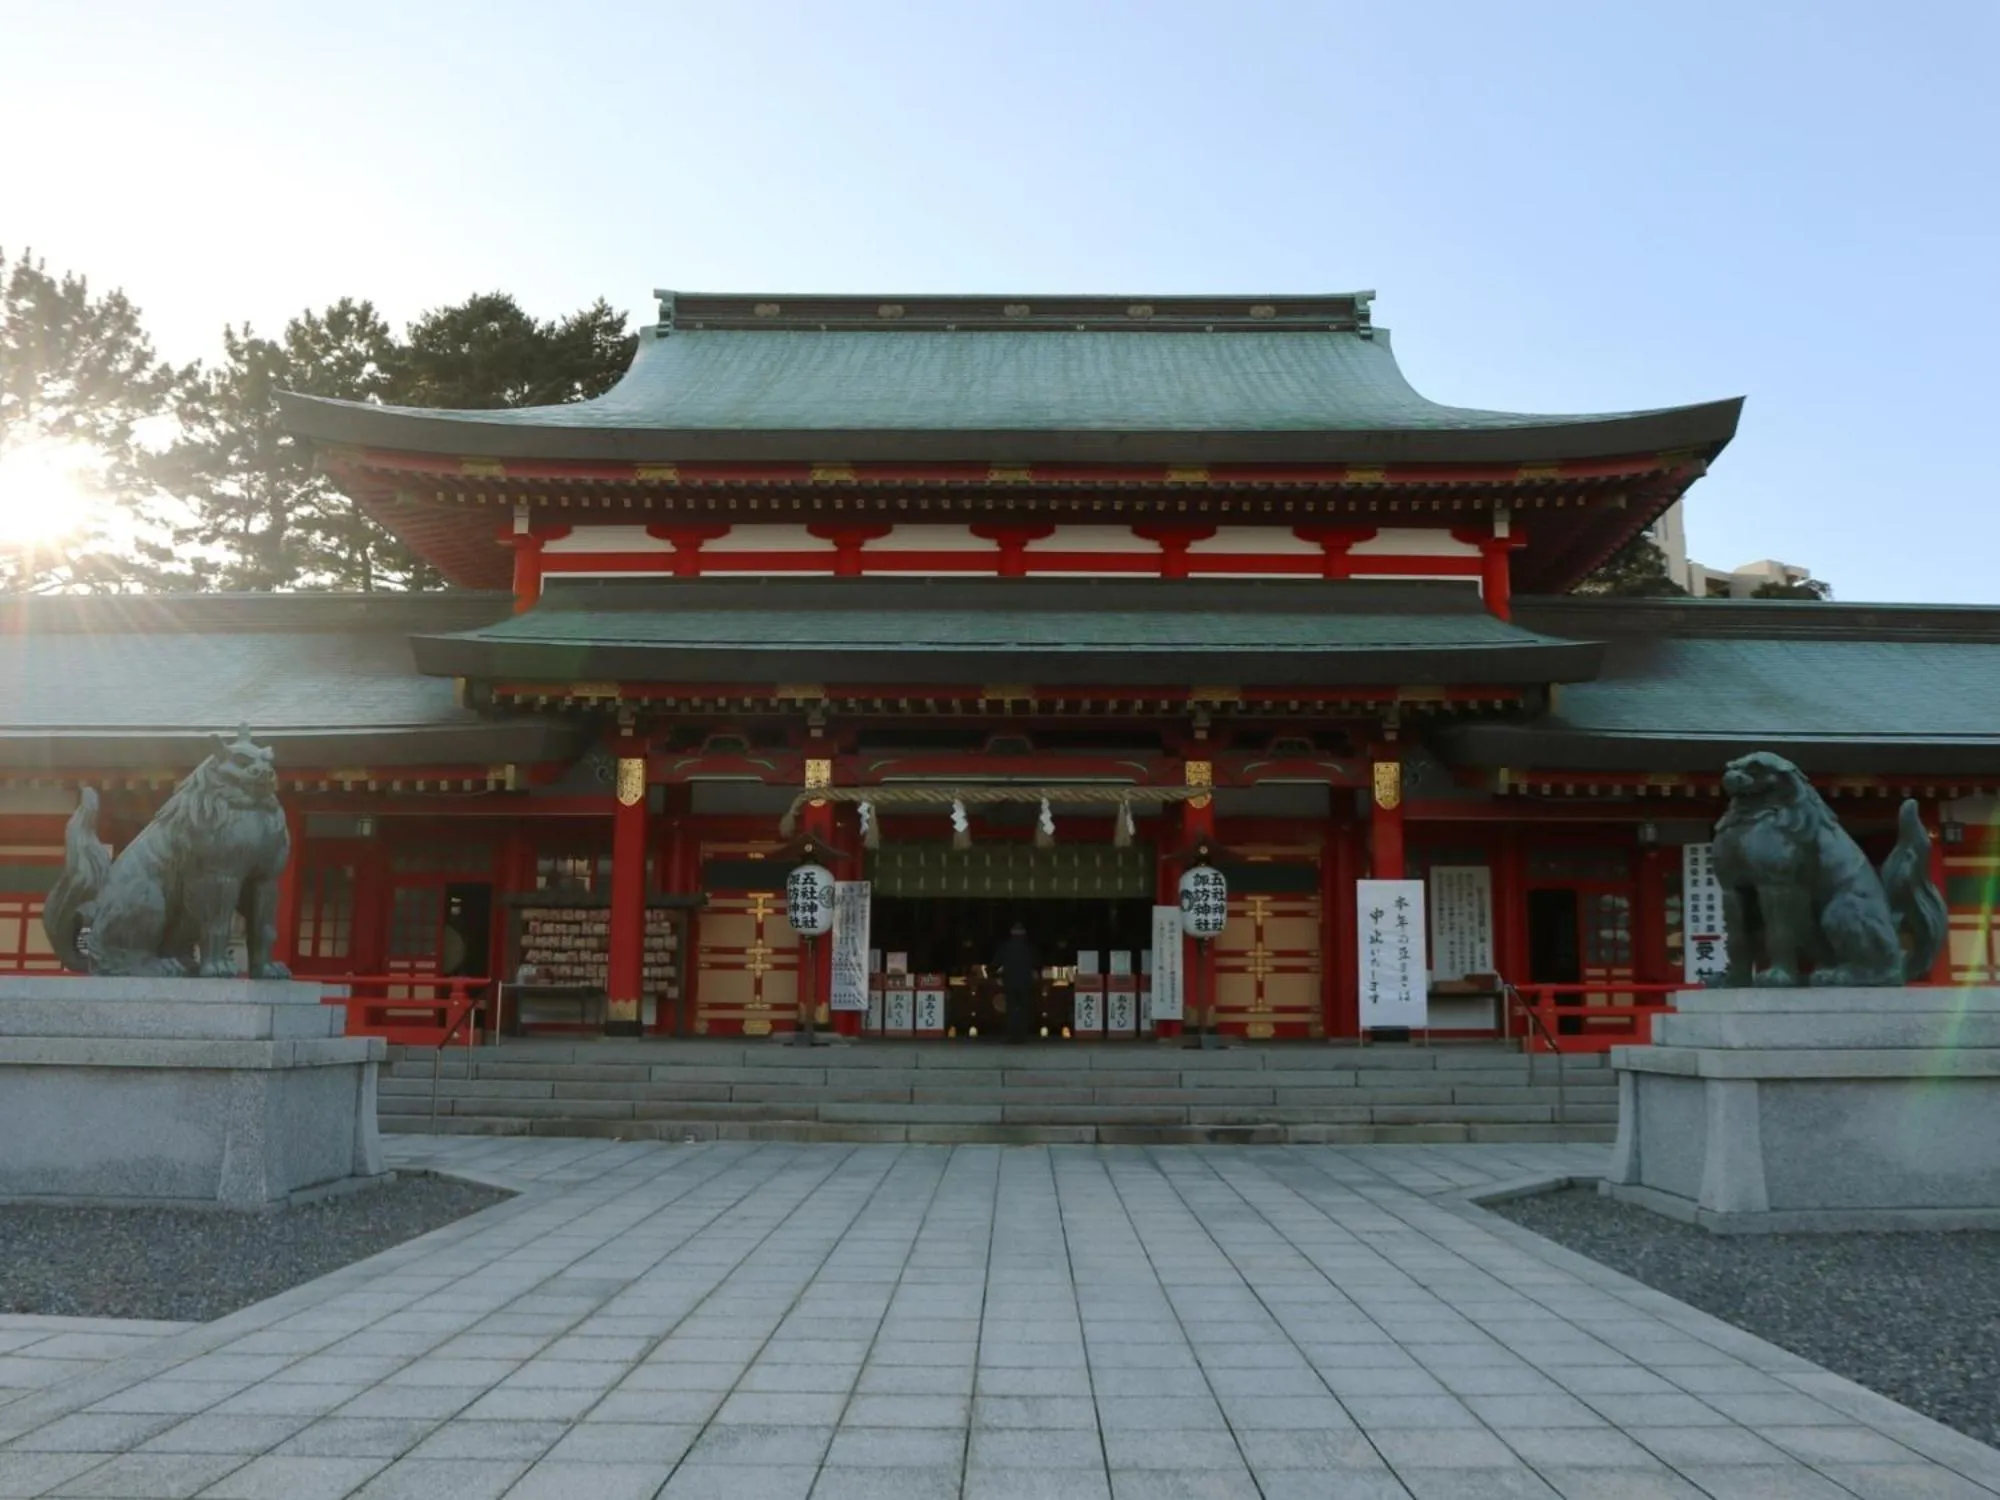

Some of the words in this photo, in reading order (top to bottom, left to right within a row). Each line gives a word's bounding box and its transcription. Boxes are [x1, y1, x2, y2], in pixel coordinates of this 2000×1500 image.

[802, 871, 818, 929] 五社神社
[1193, 872, 1210, 931] 諏訪神社
[1210, 872, 1224, 931] 五社神社
